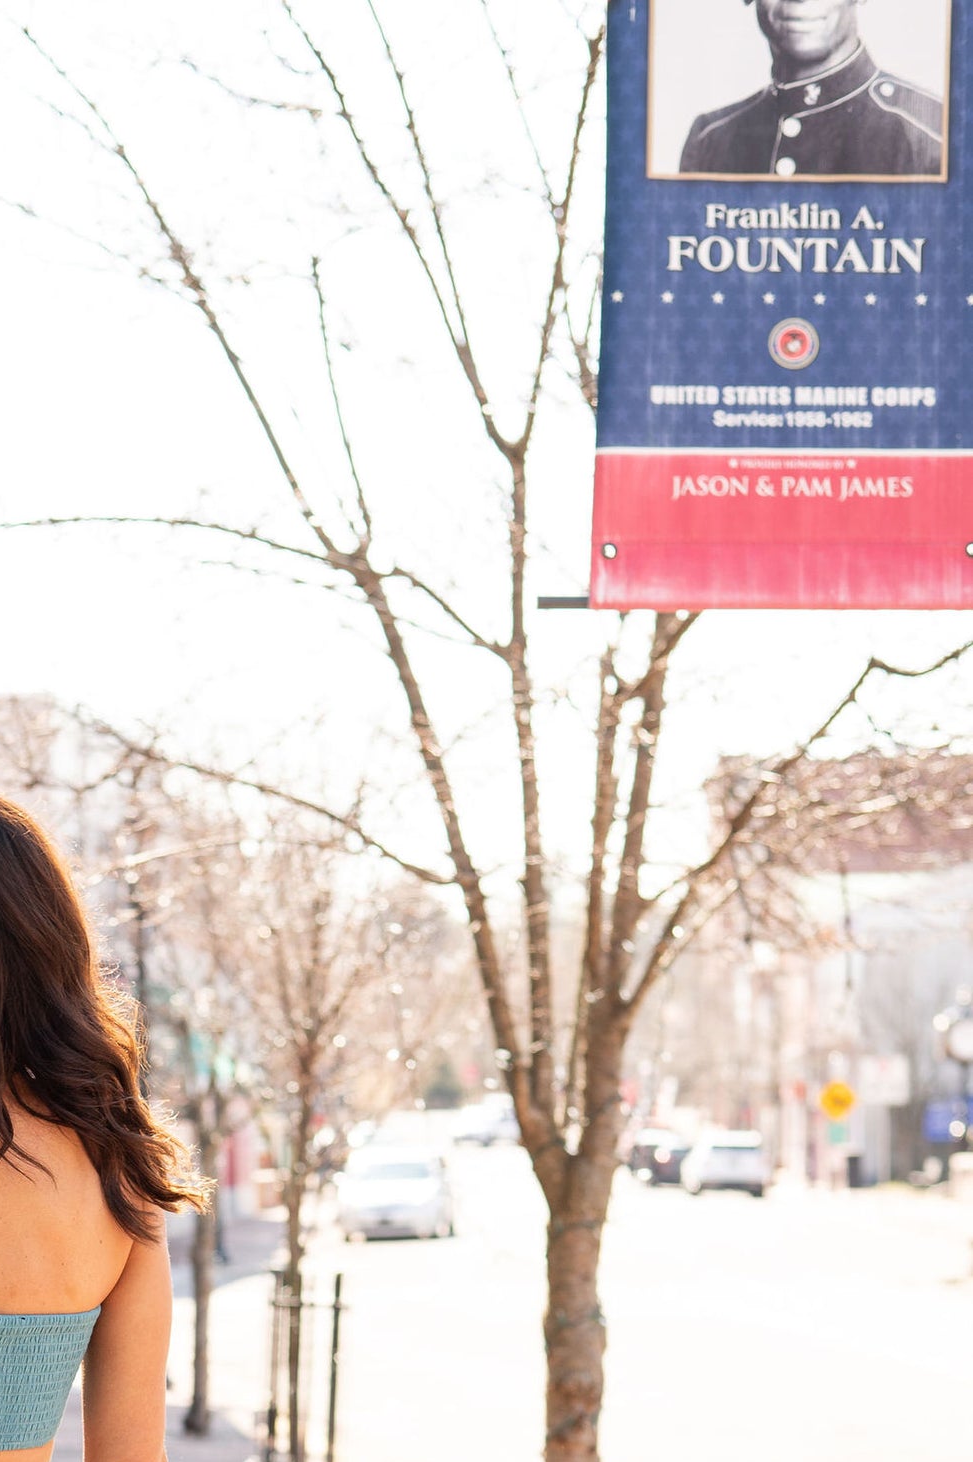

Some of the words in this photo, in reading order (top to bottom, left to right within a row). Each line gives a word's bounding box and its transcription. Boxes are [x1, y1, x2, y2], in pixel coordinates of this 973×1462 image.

[705, 202, 841, 230] Franklin
[851, 205, 885, 231] A.
[666, 235, 926, 274] FOUNTAIN
[650, 385, 720, 405] UNITED
[722, 386, 792, 406] STATES
[794, 386, 869, 407] MARINE
[871, 387, 937, 407] CORPS
[671, 474, 750, 501] JASON
[754, 475, 776, 497] &
[780, 476, 833, 498] PAM
[838, 476, 915, 503] JAMES
